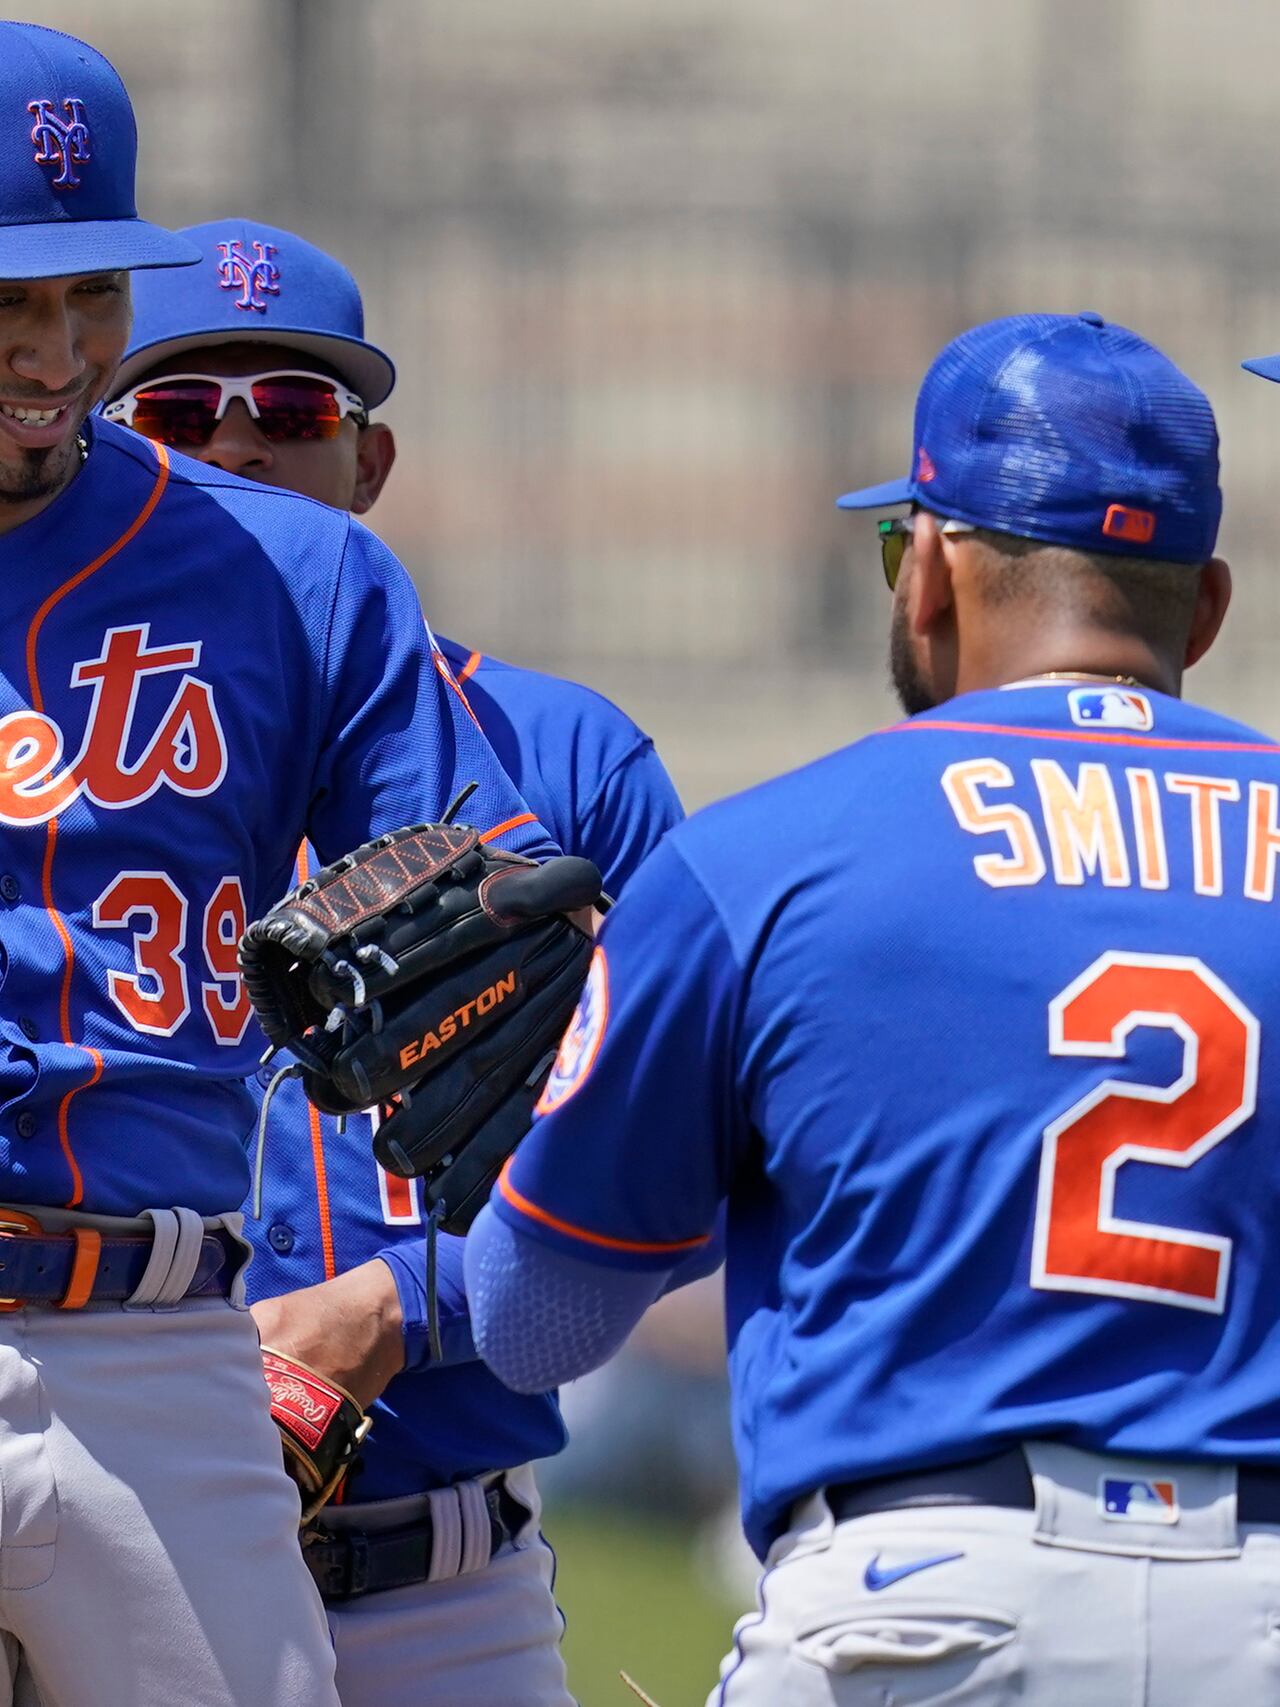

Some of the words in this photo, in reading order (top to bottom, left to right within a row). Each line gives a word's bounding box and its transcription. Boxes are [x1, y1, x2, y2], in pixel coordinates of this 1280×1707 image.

[92, 870, 256, 1046] 39
[400, 970, 516, 1071] EASTON
[1029, 949, 1261, 1315] 2
